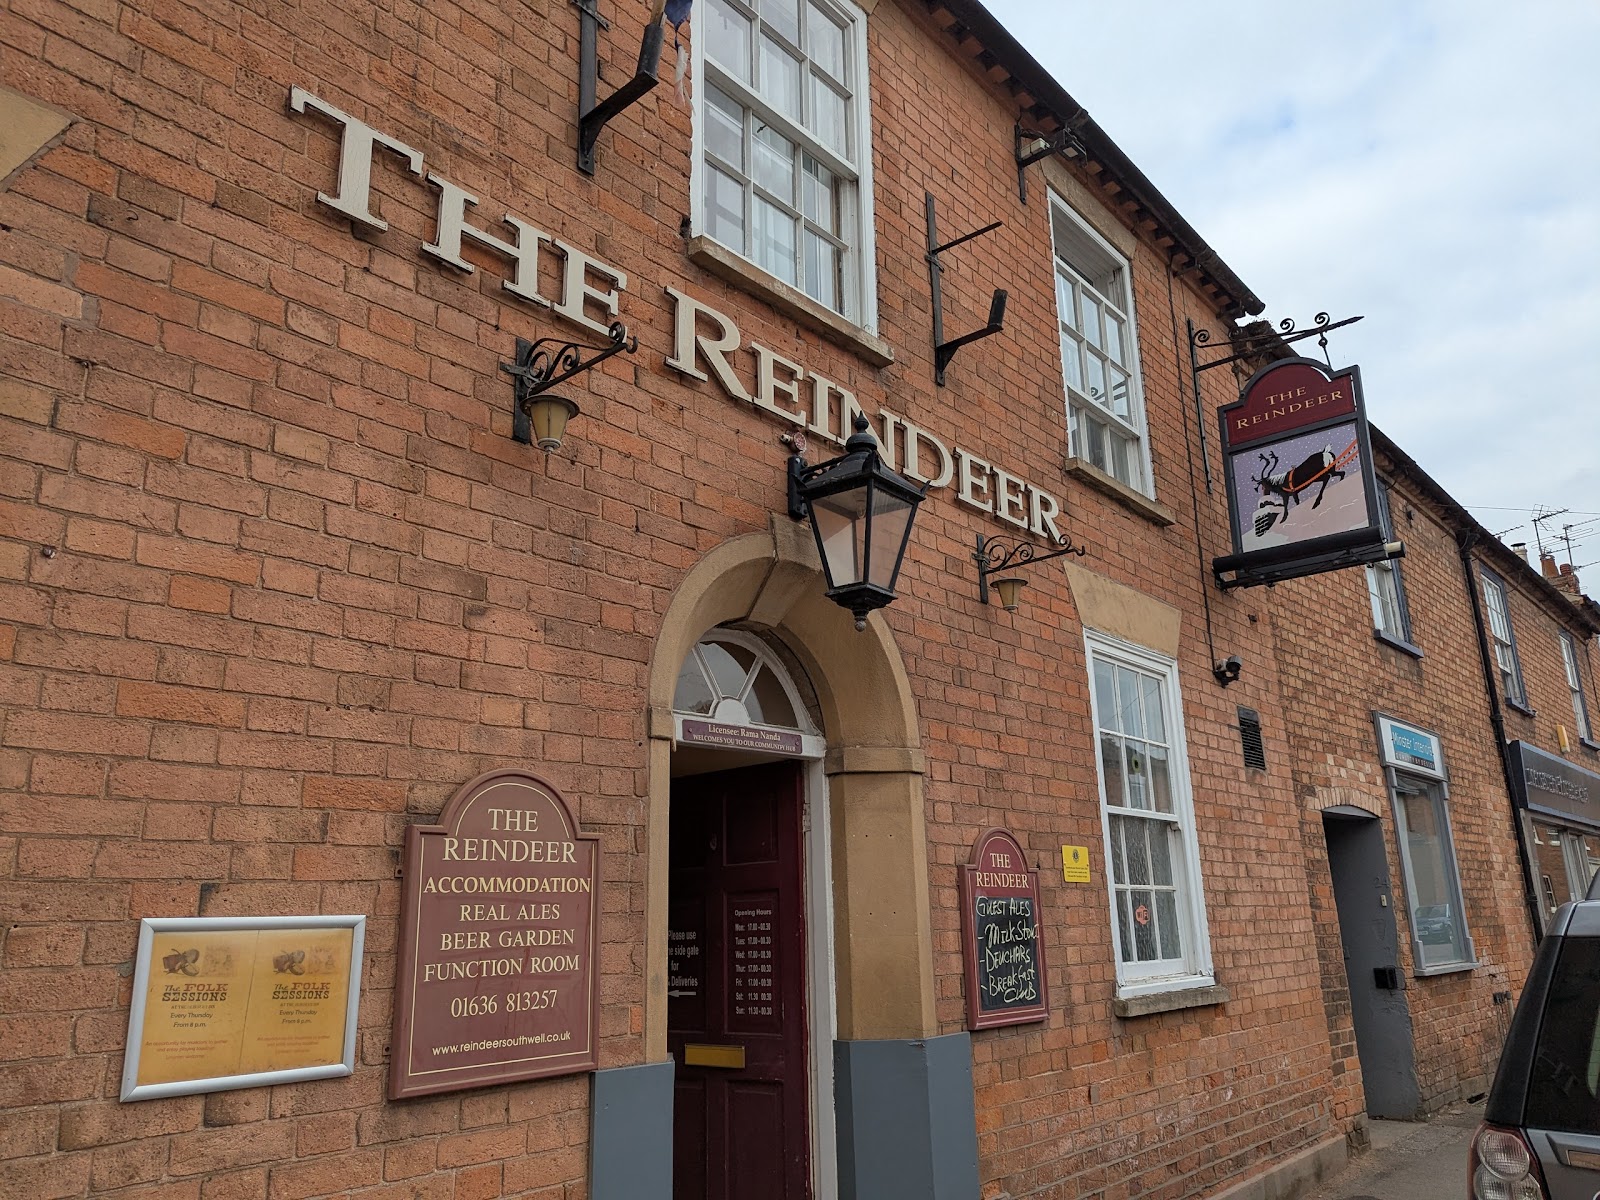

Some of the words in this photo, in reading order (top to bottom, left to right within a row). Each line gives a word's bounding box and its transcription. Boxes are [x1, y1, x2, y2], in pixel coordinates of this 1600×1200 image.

[290, 83, 628, 342] THE
[664, 286, 1062, 543] REINDEER
[1265, 386, 1307, 406] THE
[1236, 390, 1343, 430] REINDEER
[708, 724, 739, 736] Licensee:
[740, 728, 759, 739] Rama
[760, 731, 781, 741] Nanda
[692, 734, 722, 744] WELCOMES
[723, 737, 735, 745] YOU
[743, 740, 755, 748] OUR
[756, 741, 785, 751] COMMUNITY
[487, 808, 539, 832] THE
[442, 837, 577, 864] REINDEER
[990, 852, 1012, 869] THE
[423, 876, 591, 894] ACCOMMODATION
[975, 871, 1030, 889] REINDEER
[459, 904, 510, 921] REAL
[516, 903, 560, 921] ALES
[440, 932, 492, 951] BEER
[498, 928, 575, 948] GARDEN
[686, 931, 697, 940] use
[674, 945, 686, 956] side
[686, 945, 700, 958] gate
[423, 957, 523, 982] FUNCTION
[530, 955, 580, 974] ROOM
[670, 960, 680, 971] for
[183, 983, 229, 992] FOLK
[274, 983, 289, 991] The
[291, 982, 331, 991] FOLK
[671, 976, 698, 987] Deliveries
[161, 992, 227, 1002] SESSIONS
[272, 990, 330, 1000] SESSIONS
[451, 995, 498, 1018] 01636
[506, 989, 558, 1013] 813257
[170, 1012, 187, 1020] Every
[188, 1012, 214, 1020] Thursday
[432, 1030, 571, 1056] www.reindeersouthwell.co.uk
